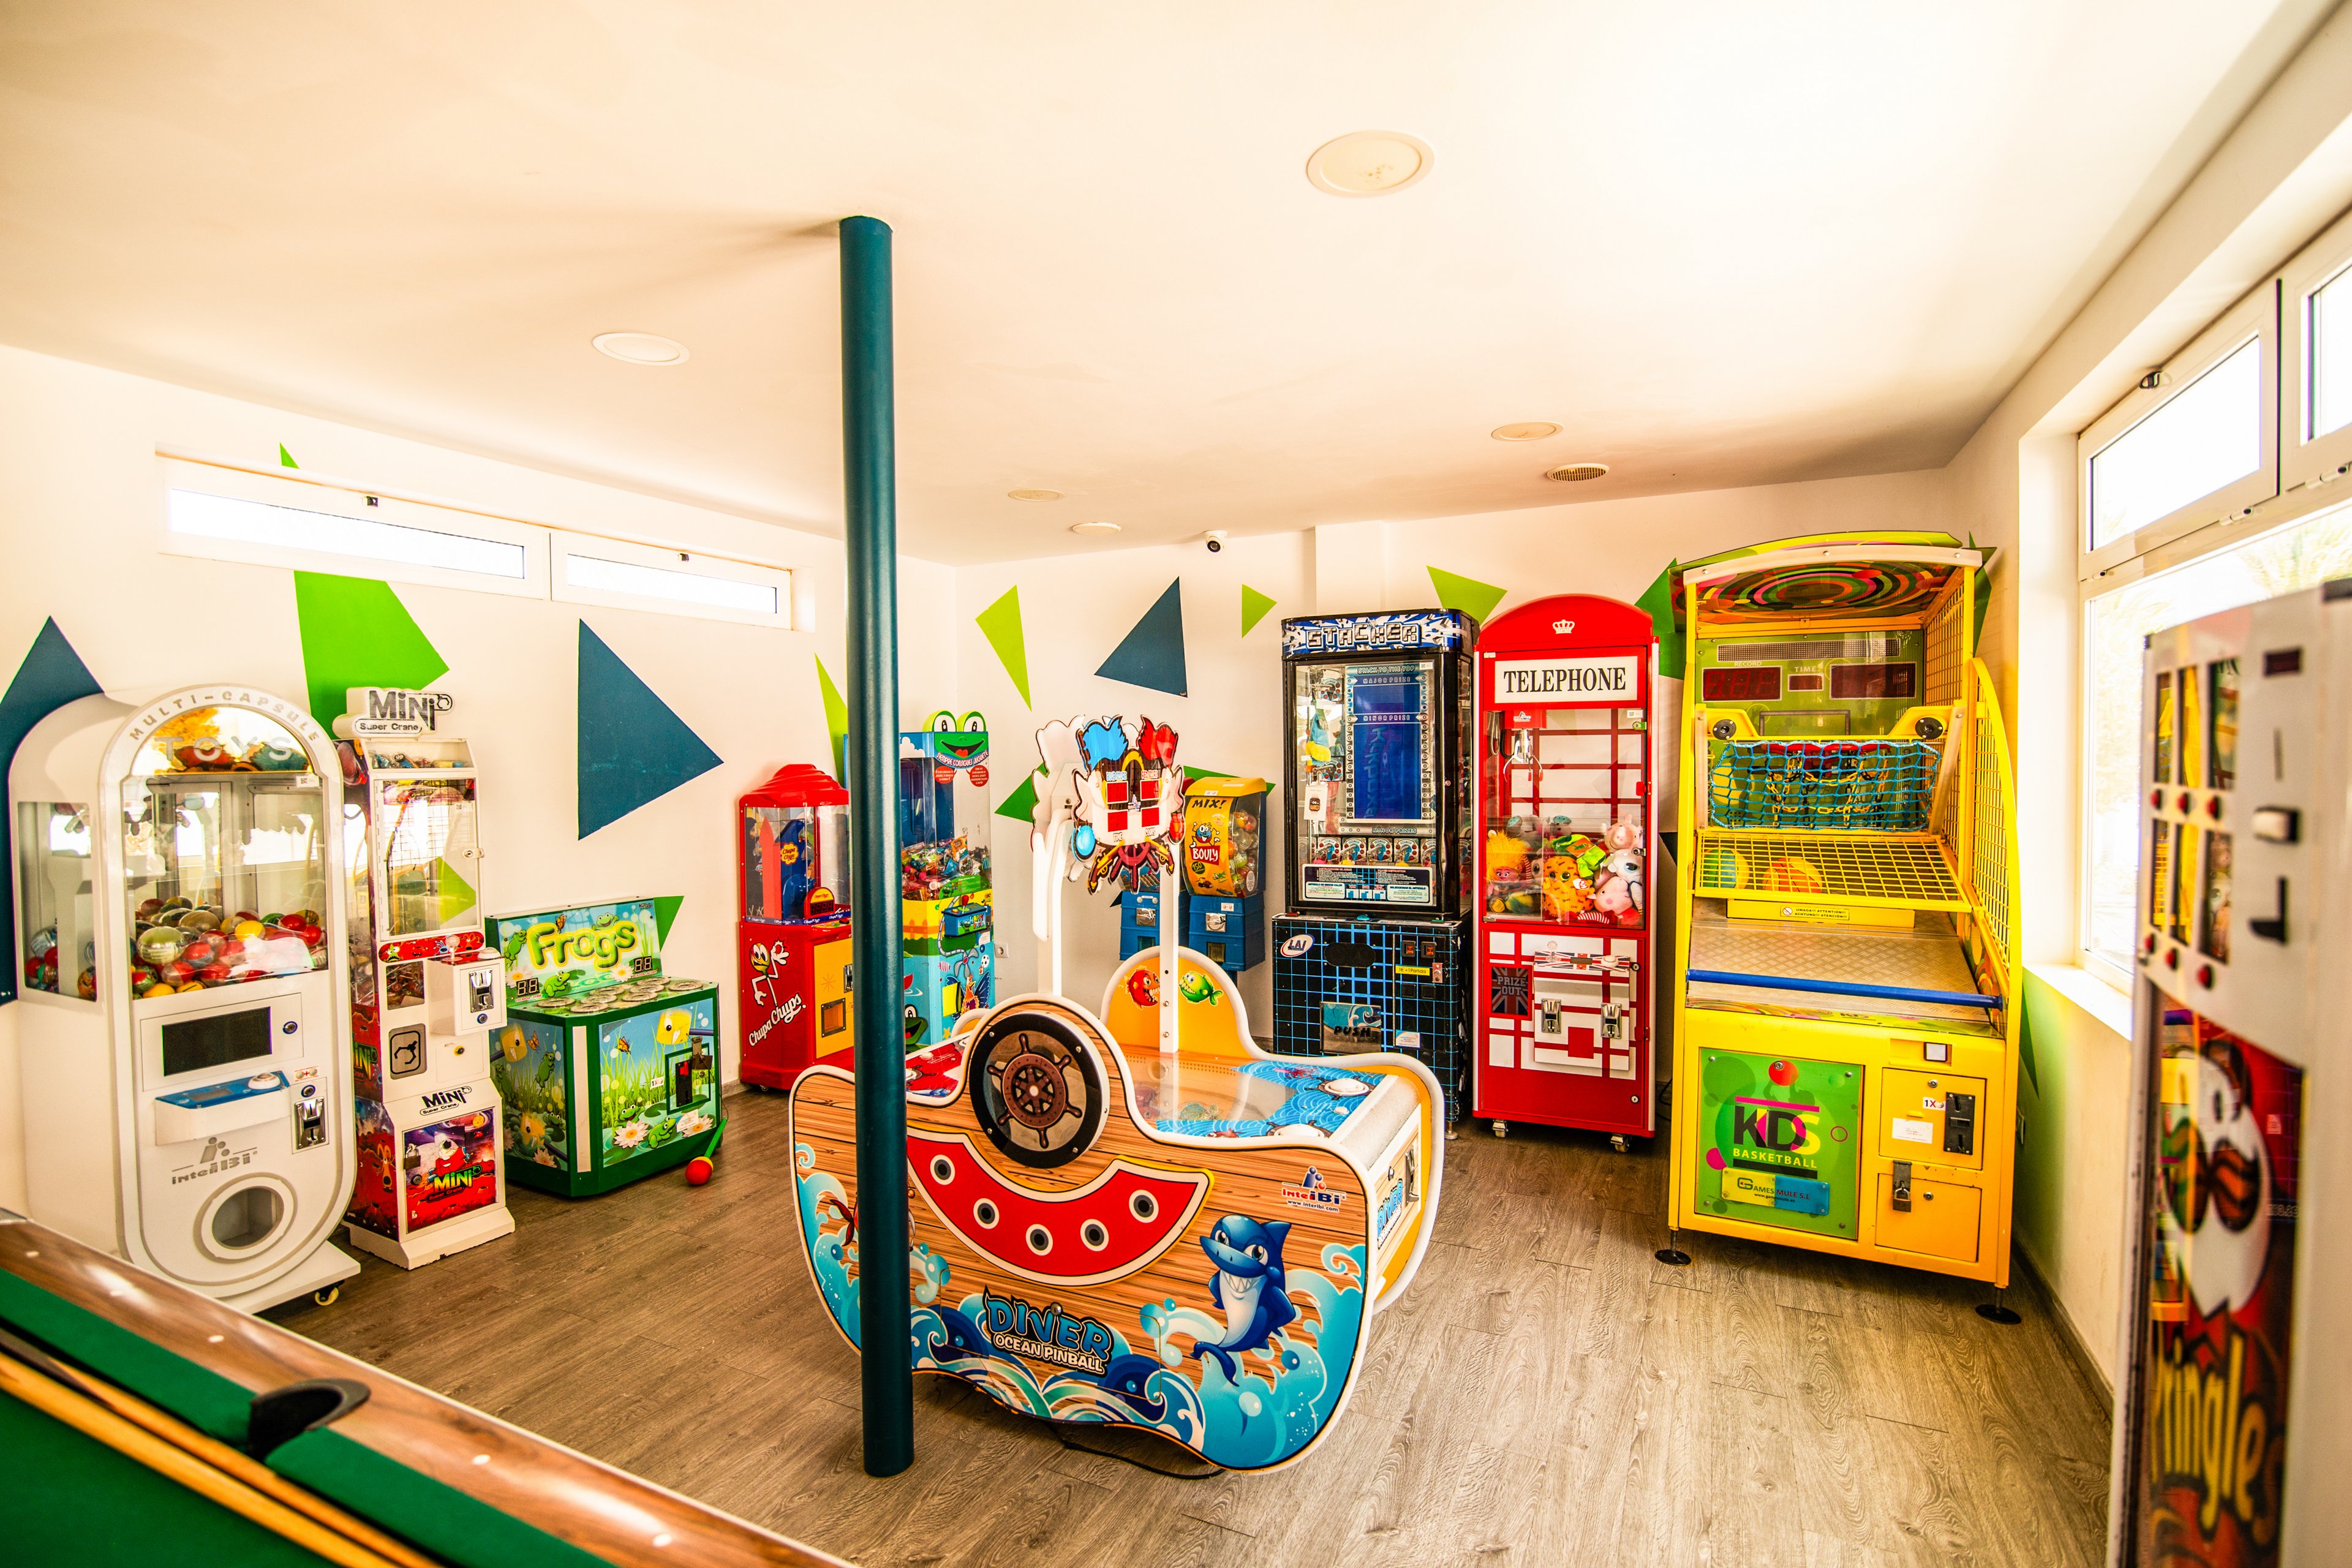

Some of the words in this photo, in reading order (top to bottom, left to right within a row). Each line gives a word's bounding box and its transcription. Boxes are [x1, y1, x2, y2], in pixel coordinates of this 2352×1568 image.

[1308, 623, 1419, 647] STACKER
[1504, 667, 1626, 693] TELEPHONE
[129, 690, 320, 742] MULTI-CAPSULE
[154, 736, 292, 762] TOYS
[936, 752, 953, 766] SIEMPRE
[953, 758, 973, 767] CONSIGUES
[973, 750, 989, 764] JUGUETE
[1192, 799, 1227, 809] MIX!
[1113, 832, 1123, 842] TIME
[1193, 848, 1219, 862] BOULY
[526, 922, 636, 970] Frogs
[1288, 939, 1307, 951] LAI
[1497, 976, 1526, 987] PRIZE
[1501, 986, 1522, 996] OUT
[748, 1019, 772, 1047] Chupa
[1333, 1025, 1371, 1038] PUSH
[1733, 1148, 1817, 1169] BASKETBALL
[1754, 1193, 1795, 1204] www.gamesmule.es
[1776, 1189, 1798, 1198] MULE
[1287, 1199, 1339, 1212] www.interibi.com
[985, 1294, 1112, 1362] DIVER
[995, 1333, 1041, 1357] OCEAN
[1044, 1346, 1103, 1372] PINBALL
